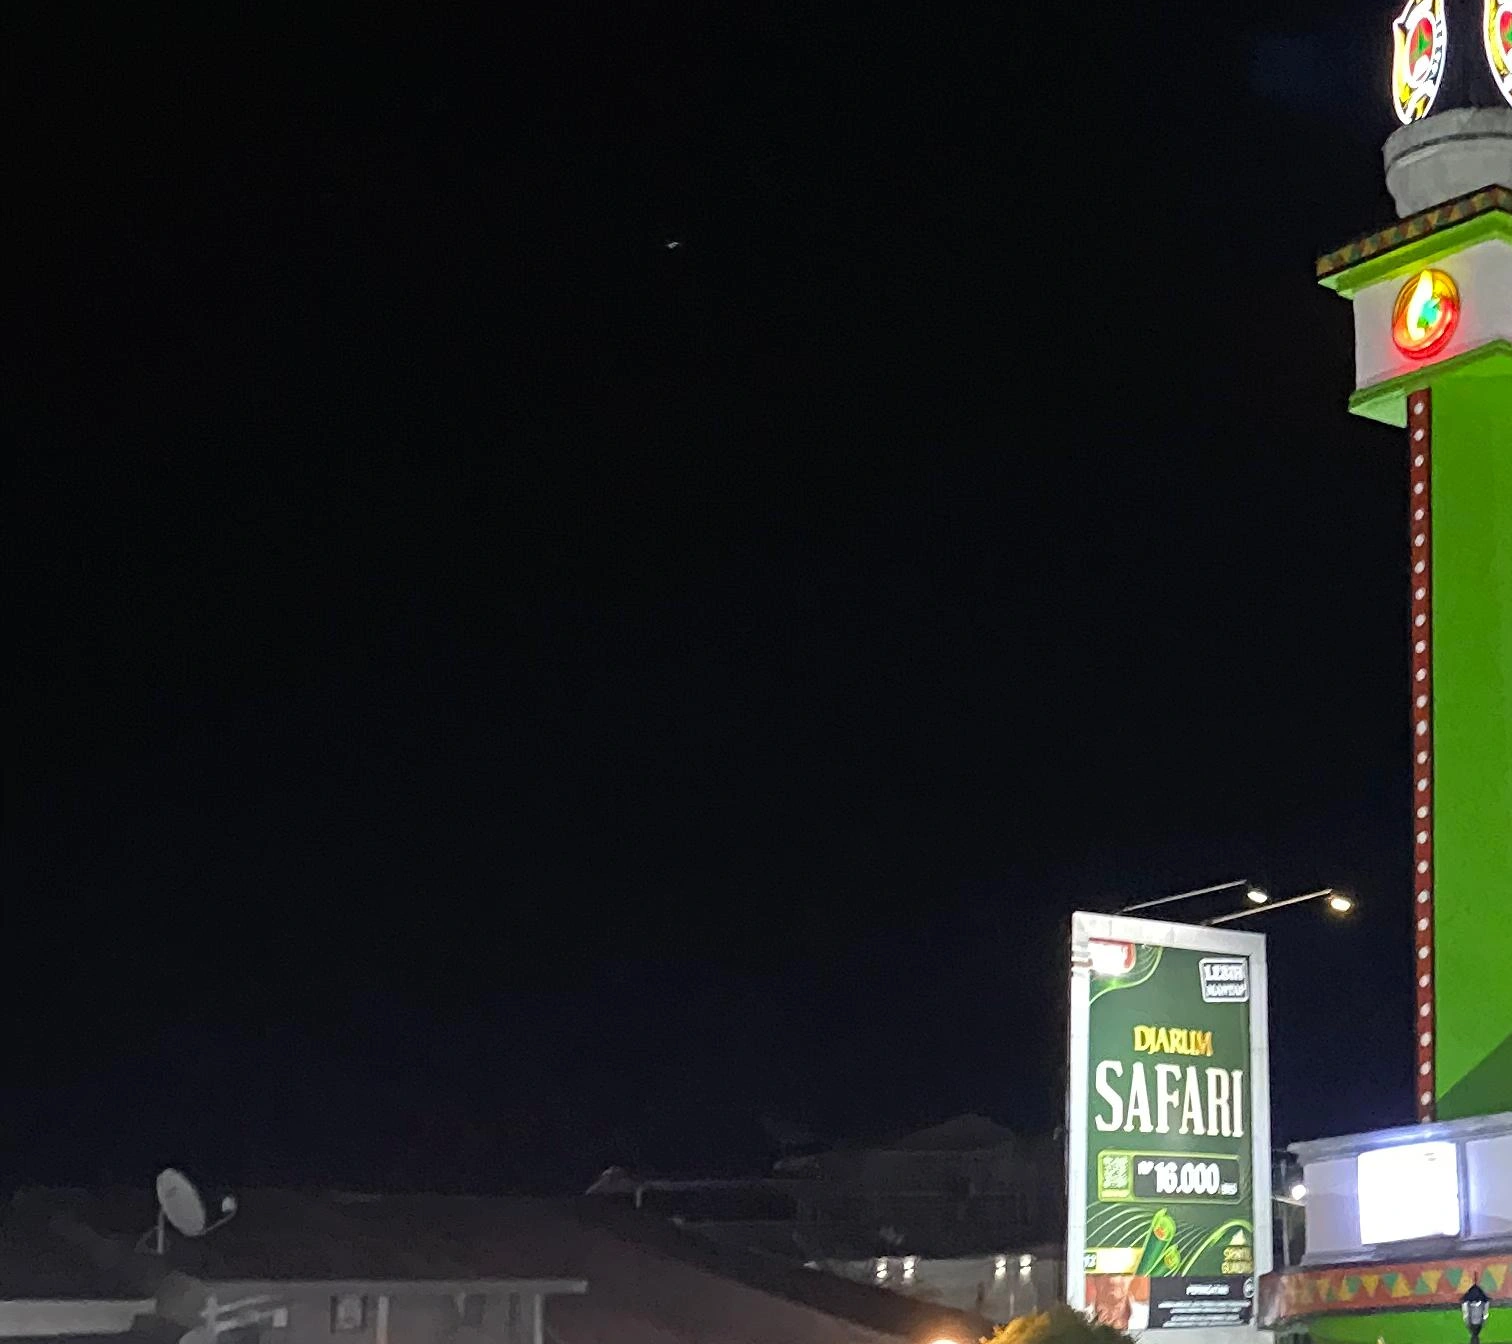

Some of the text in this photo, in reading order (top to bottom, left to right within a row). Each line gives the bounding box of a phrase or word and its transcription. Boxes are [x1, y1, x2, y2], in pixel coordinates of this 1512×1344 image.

[1134, 1025, 1213, 1056] DJARUM
[1094, 1059, 1244, 1137] SAFARI
[1154, 1161, 1220, 1194] 16.000
